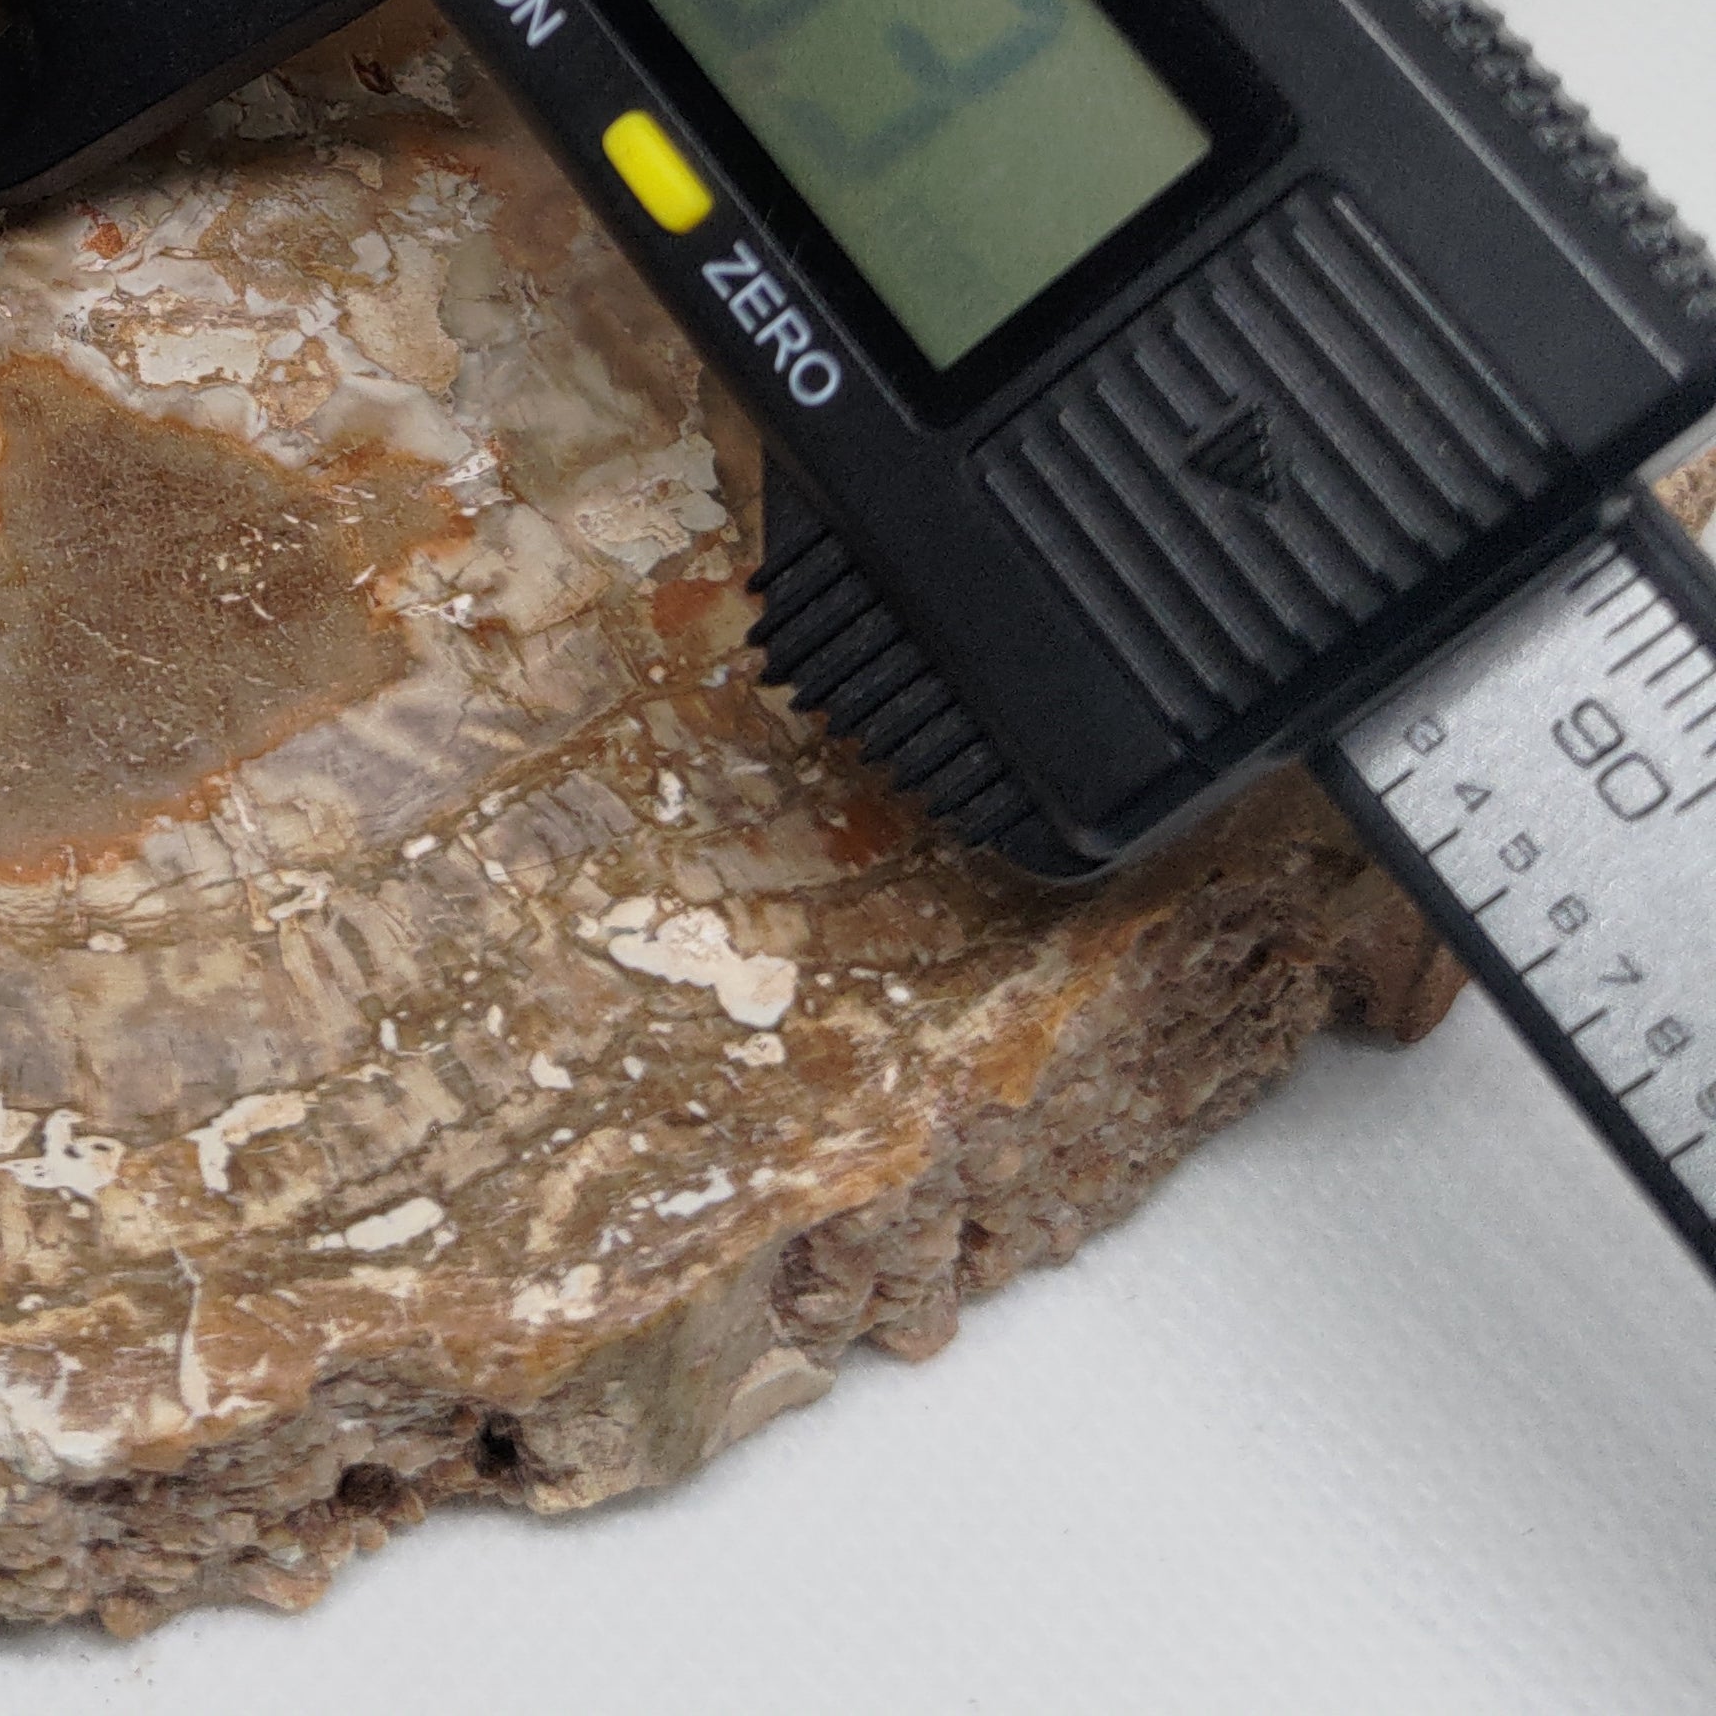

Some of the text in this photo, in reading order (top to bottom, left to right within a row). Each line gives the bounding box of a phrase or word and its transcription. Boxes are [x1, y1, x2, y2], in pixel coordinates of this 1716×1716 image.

[700, 238, 842, 408] ZERO
[1550, 696, 1672, 823] 90
[1453, 781, 1492, 814] 4
[1498, 831, 1542, 874] 5
[1547, 893, 1590, 936] 6
[1598, 953, 1644, 987] 7
